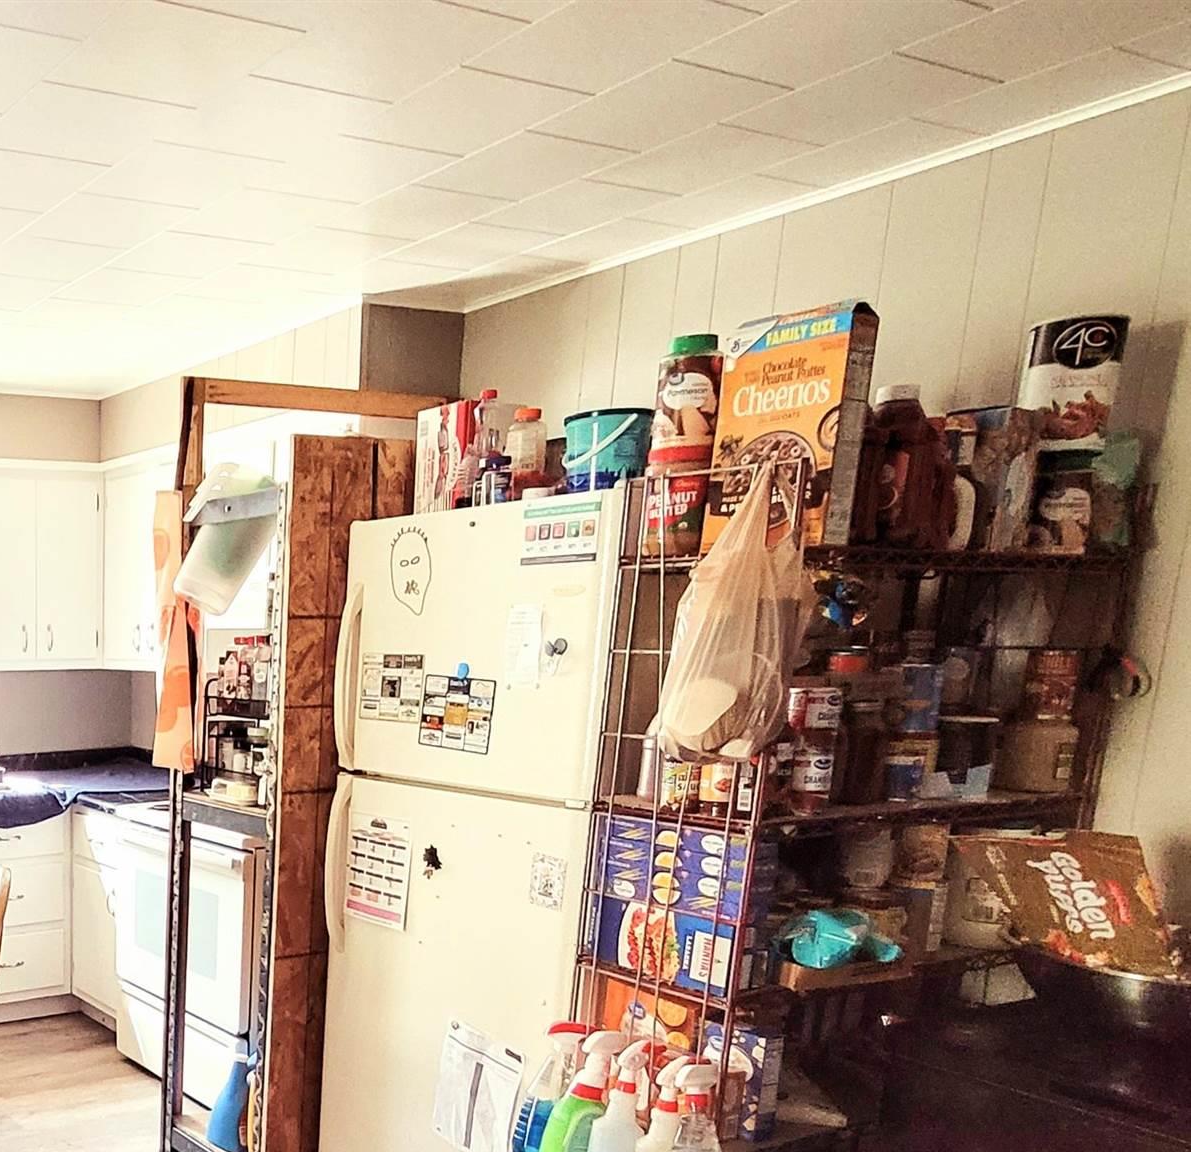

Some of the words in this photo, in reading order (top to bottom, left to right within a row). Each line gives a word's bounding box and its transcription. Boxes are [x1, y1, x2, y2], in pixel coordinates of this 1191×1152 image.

[765, 324, 808, 348] FAMILY
[809, 318, 837, 338] SIZE
[1059, 326, 1110, 366] 4C
[761, 369, 794, 387] Peanut
[796, 364, 826, 382] Butter
[762, 356, 808, 375] Chocolate
[732, 379, 832, 417] Cheerios
[648, 490, 698, 509] PEANUT
